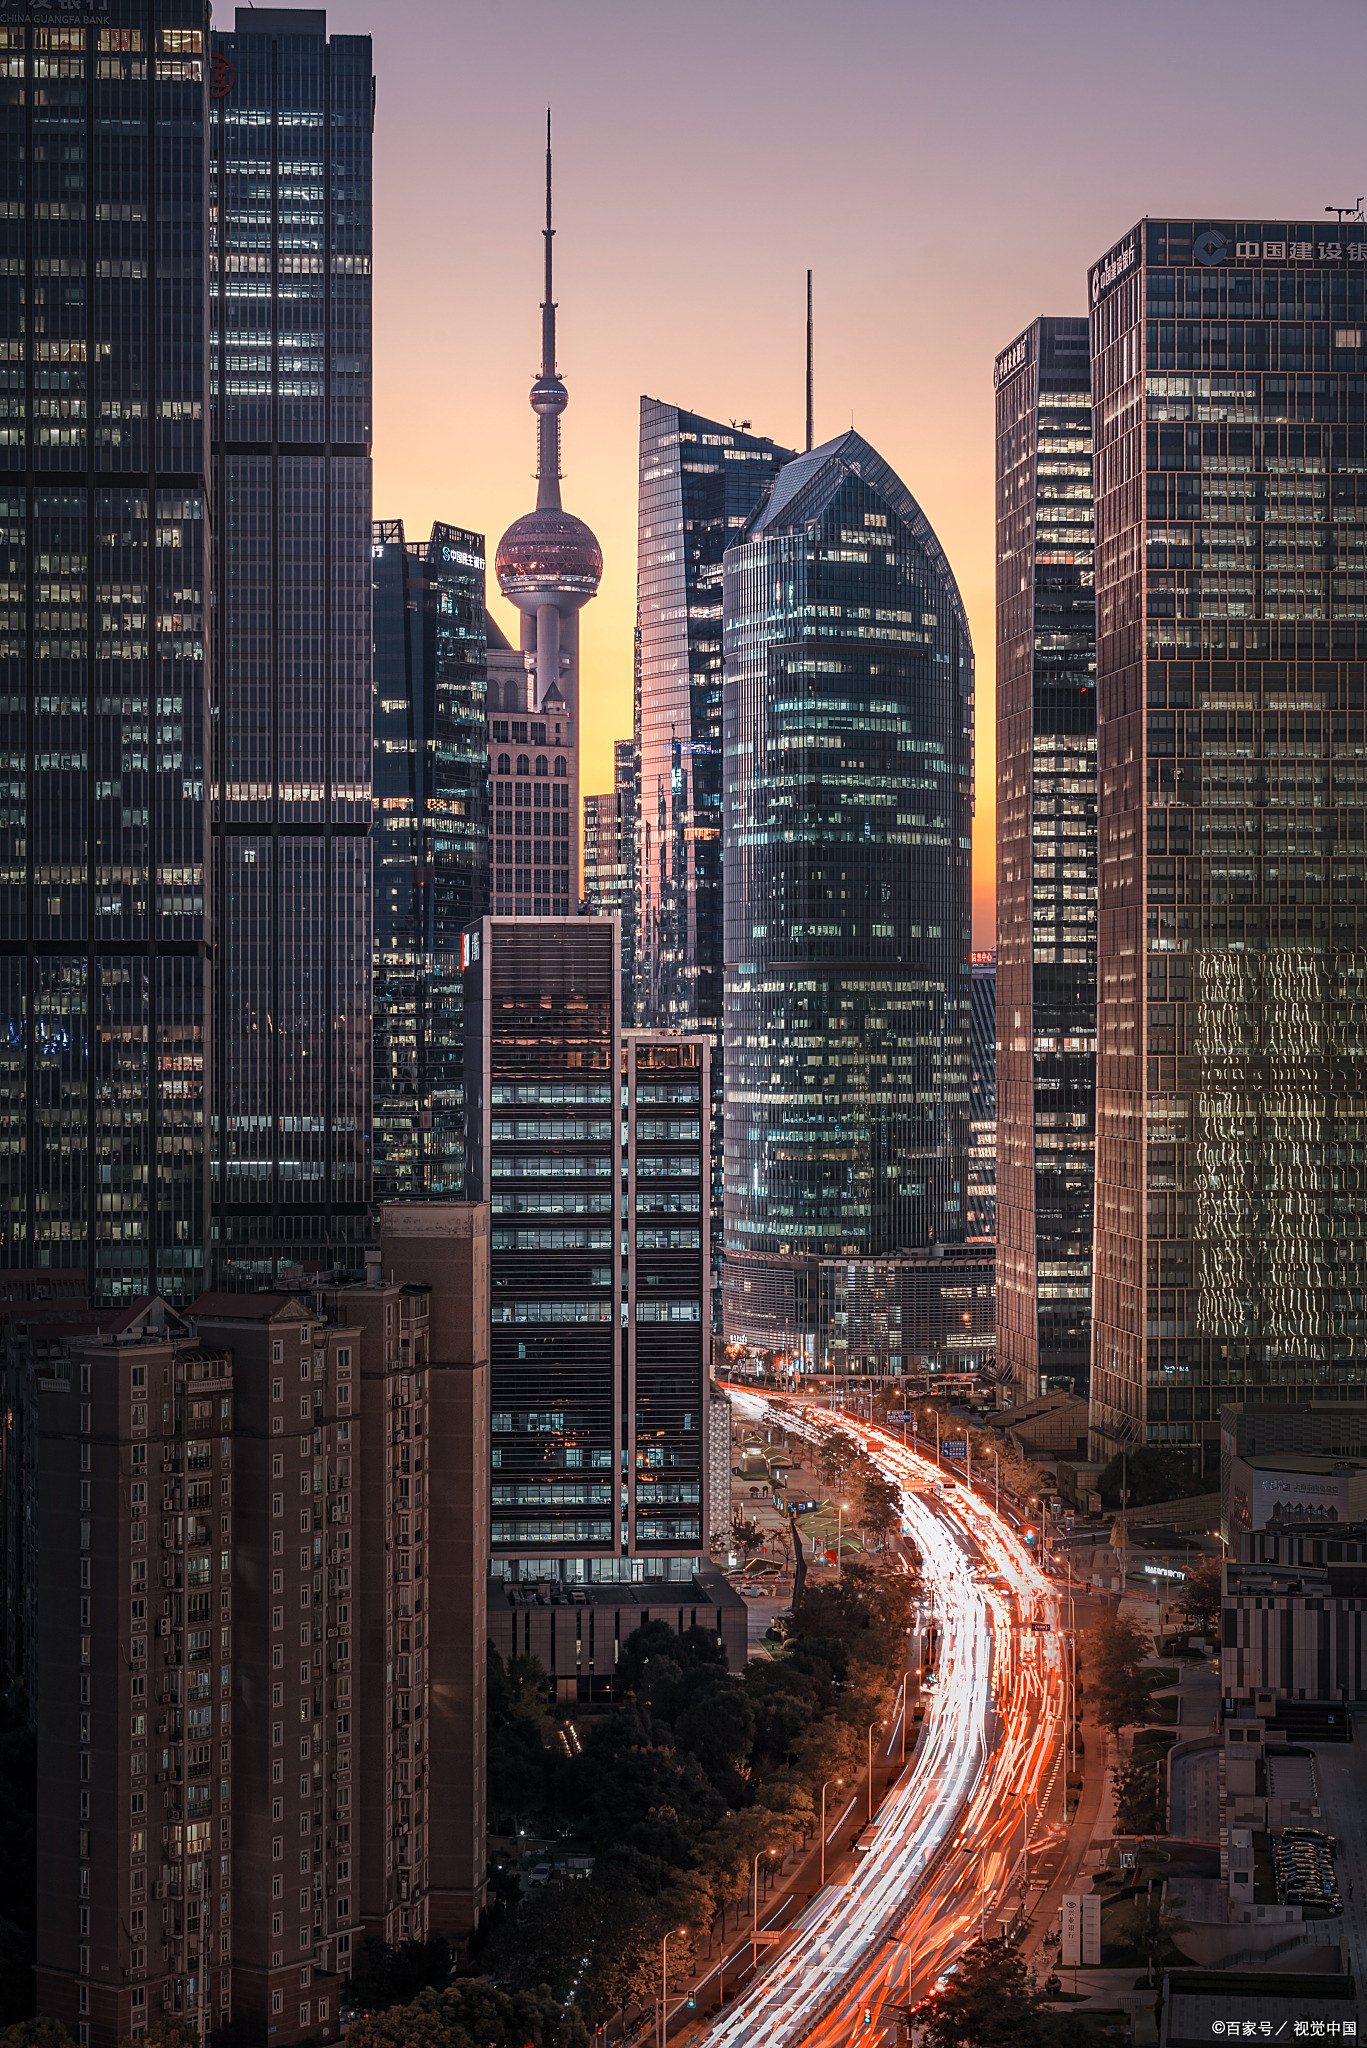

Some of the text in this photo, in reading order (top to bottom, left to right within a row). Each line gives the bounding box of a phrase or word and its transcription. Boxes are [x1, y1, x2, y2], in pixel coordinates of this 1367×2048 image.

[0, 14, 110, 25] CHINA GUANGFA BANK
